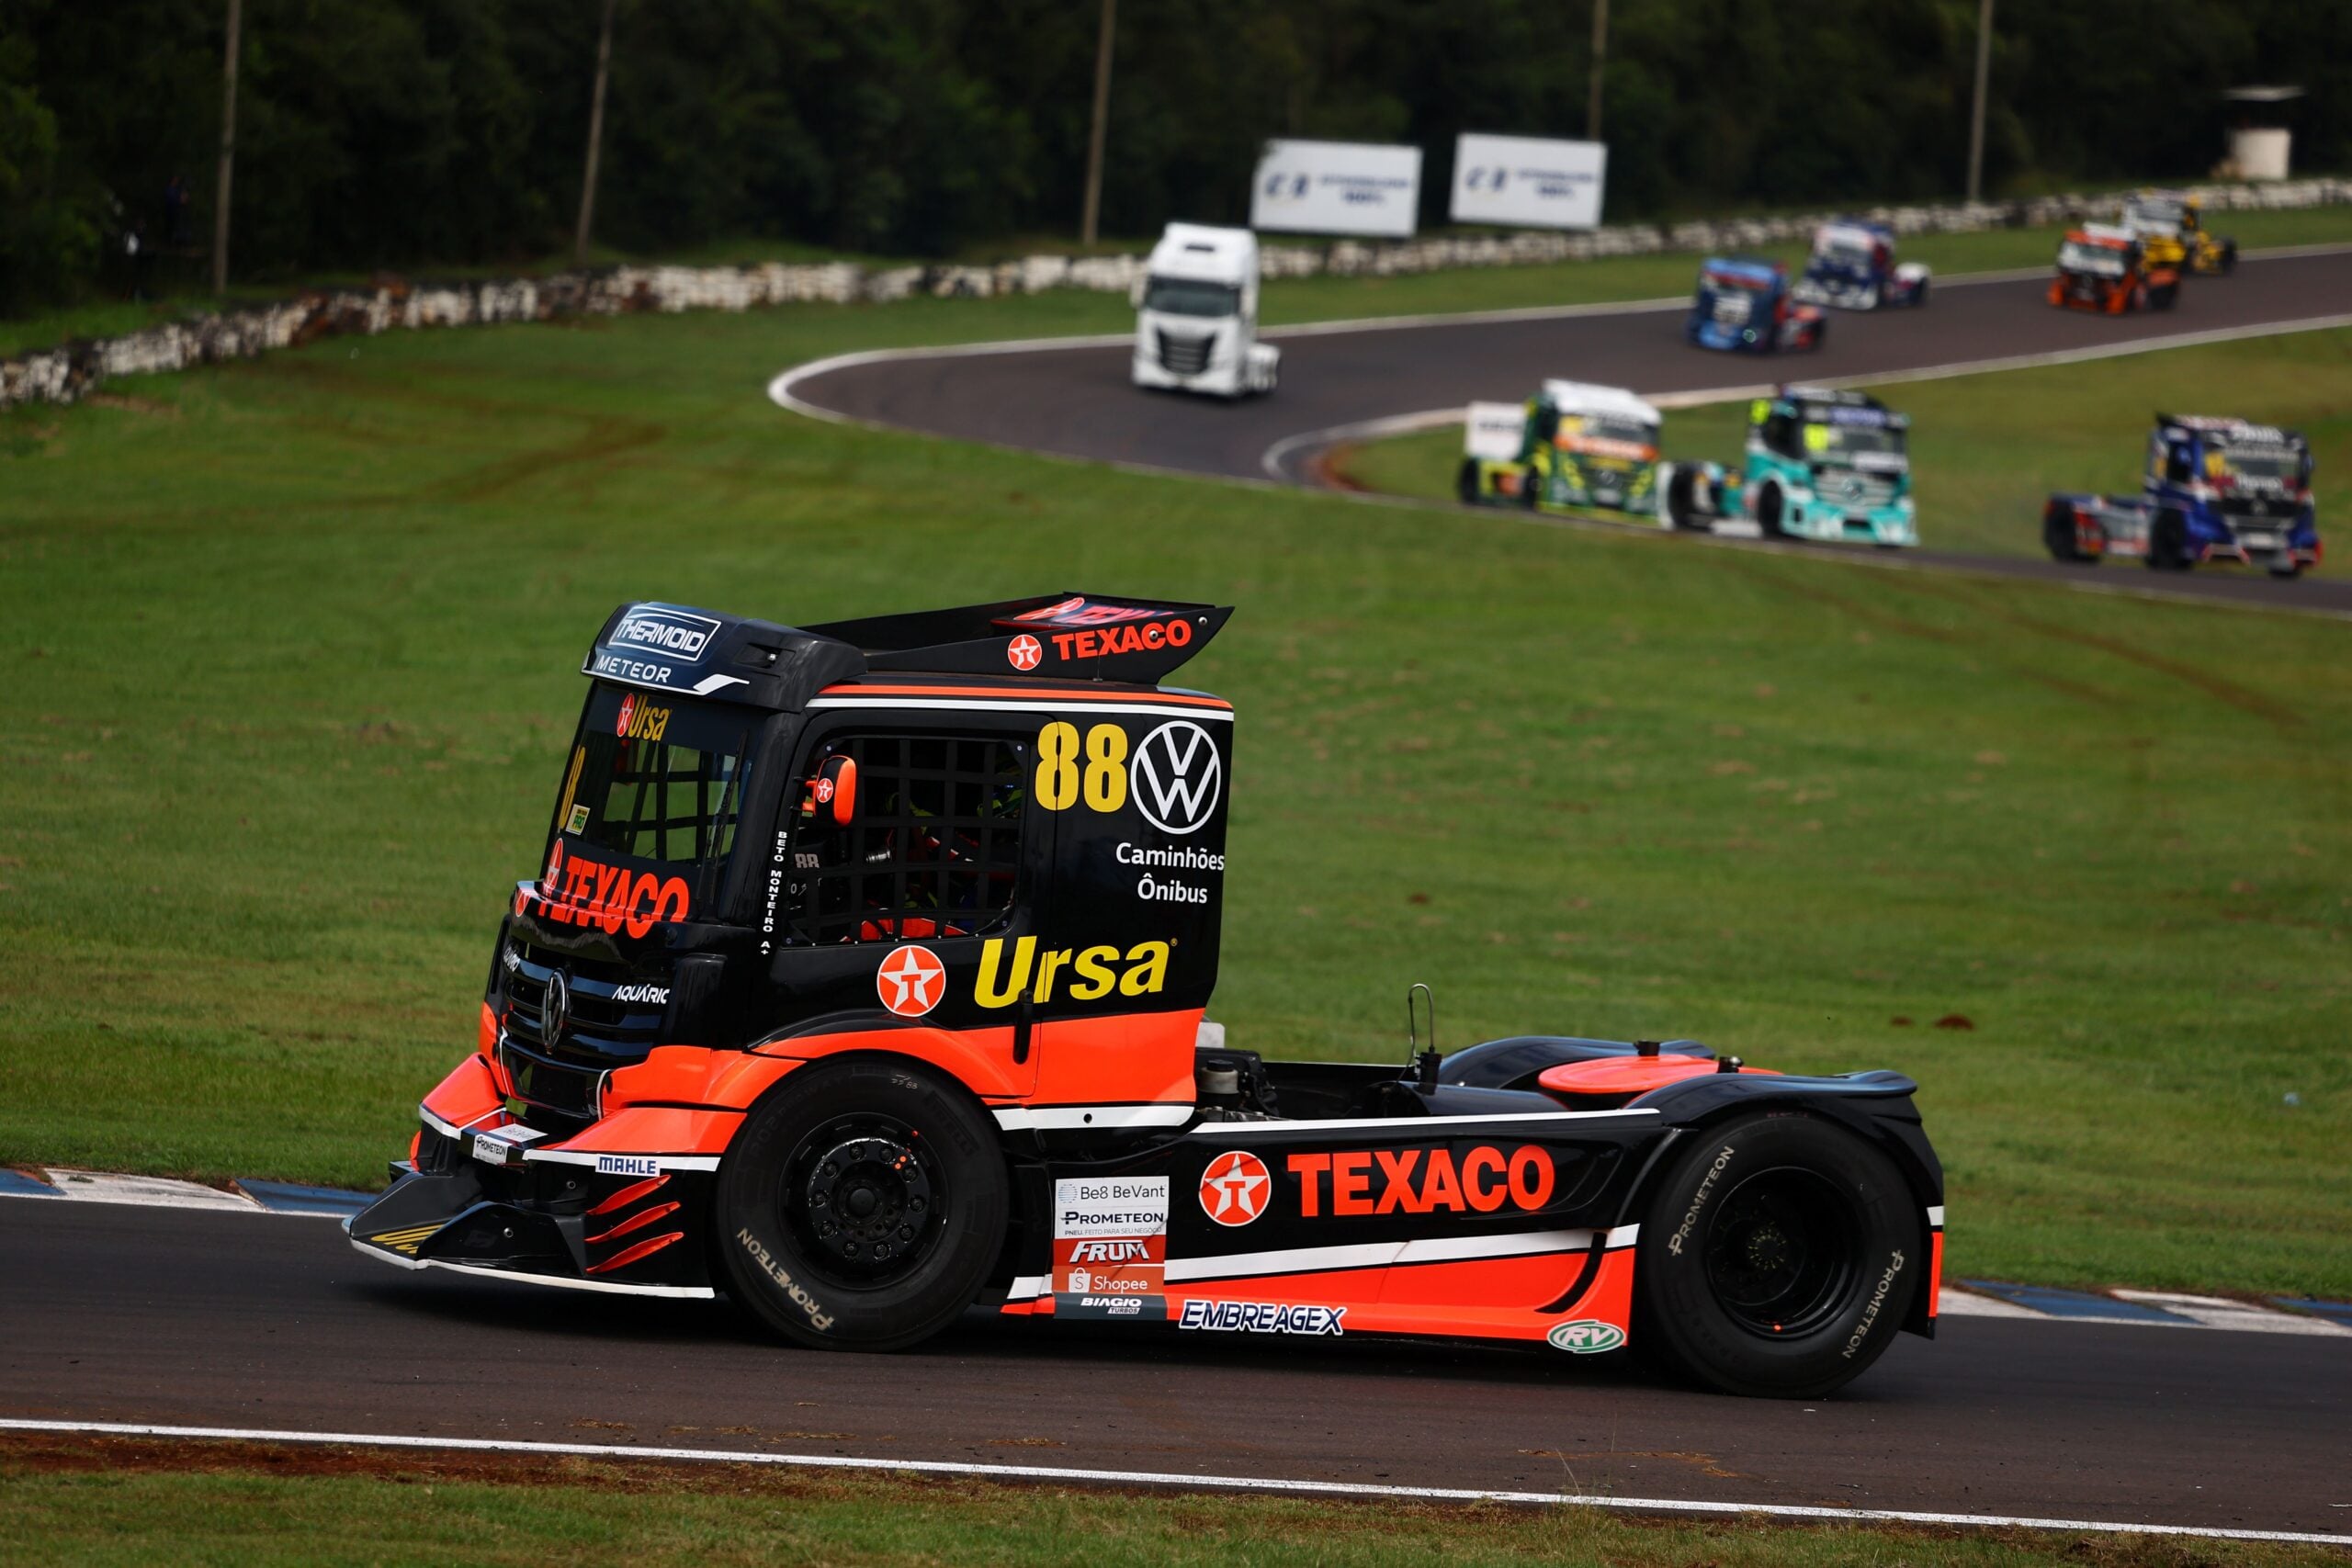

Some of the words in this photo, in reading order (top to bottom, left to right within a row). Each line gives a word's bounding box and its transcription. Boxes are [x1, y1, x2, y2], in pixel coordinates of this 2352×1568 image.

[616, 618, 706, 652] THERMOID
[1052, 619, 1192, 660] TEXACO
[596, 654, 672, 683] METEOR
[628, 694, 671, 741] Ursa
[1035, 721, 1128, 813] 88
[774, 830, 787, 862] BETO
[1115, 841, 1225, 872] Caminhões
[538, 855, 690, 939] TEXACO
[763, 869, 782, 932] MONTEIRO
[1137, 873, 1207, 904] Ônibus
[974, 935, 1170, 1009] Ursa
[476, 1135, 507, 1156] PROMETEON
[599, 1156, 656, 1174] MAHLE
[1287, 1145, 1555, 1218] TEXACO
[1080, 1186, 1109, 1200] Be8
[1113, 1185, 1165, 1199] BeVant
[1668, 1145, 1736, 1257] PROMETEON
[1060, 1212, 1164, 1225] PROMETEON
[1069, 1240, 1150, 1263] FRUM
[736, 1227, 835, 1331] PROMETEON
[1093, 1275, 1148, 1294] Shopee
[1080, 1297, 1143, 1307] BIAGIO
[1179, 1299, 1348, 1336] EMBREAGEX
[1841, 1248, 1905, 1359] PROMETEON
